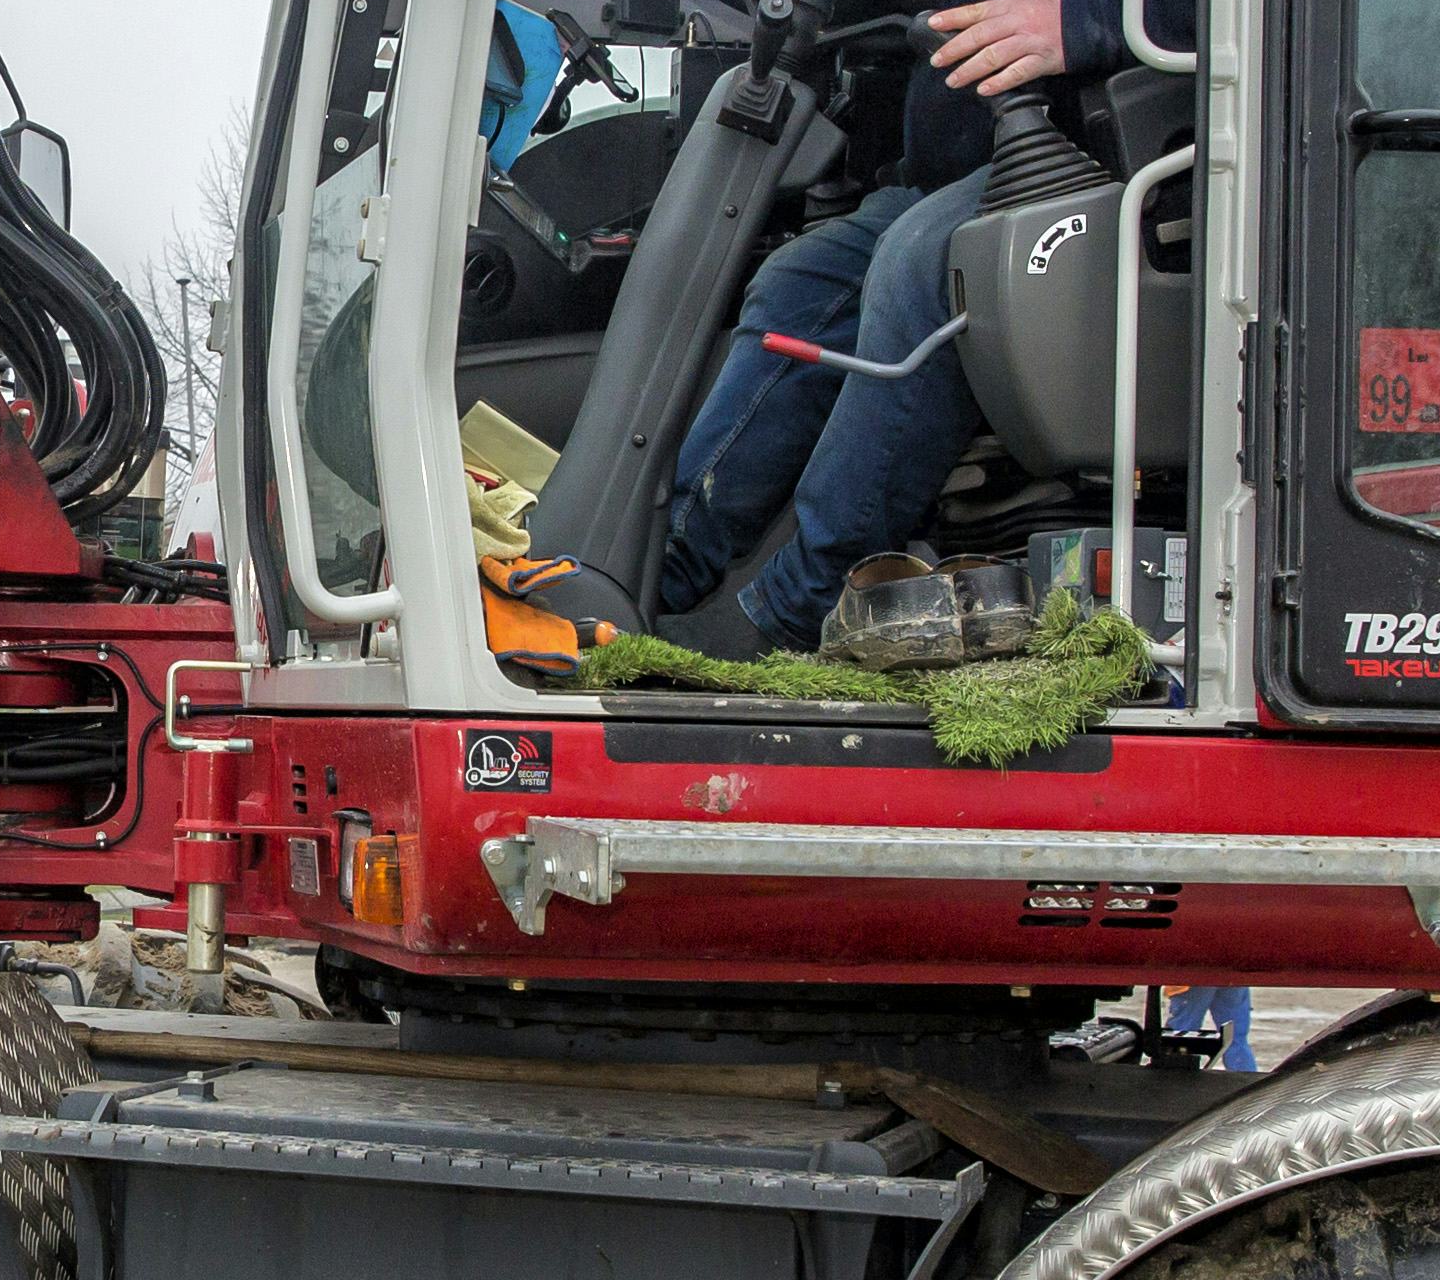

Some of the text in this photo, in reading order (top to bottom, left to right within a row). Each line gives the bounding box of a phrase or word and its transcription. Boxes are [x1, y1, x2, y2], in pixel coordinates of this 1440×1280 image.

[1370, 374, 1411, 424] 99
[518, 770, 549, 778] SECURITY
[520, 778, 546, 786] SYSTEM
